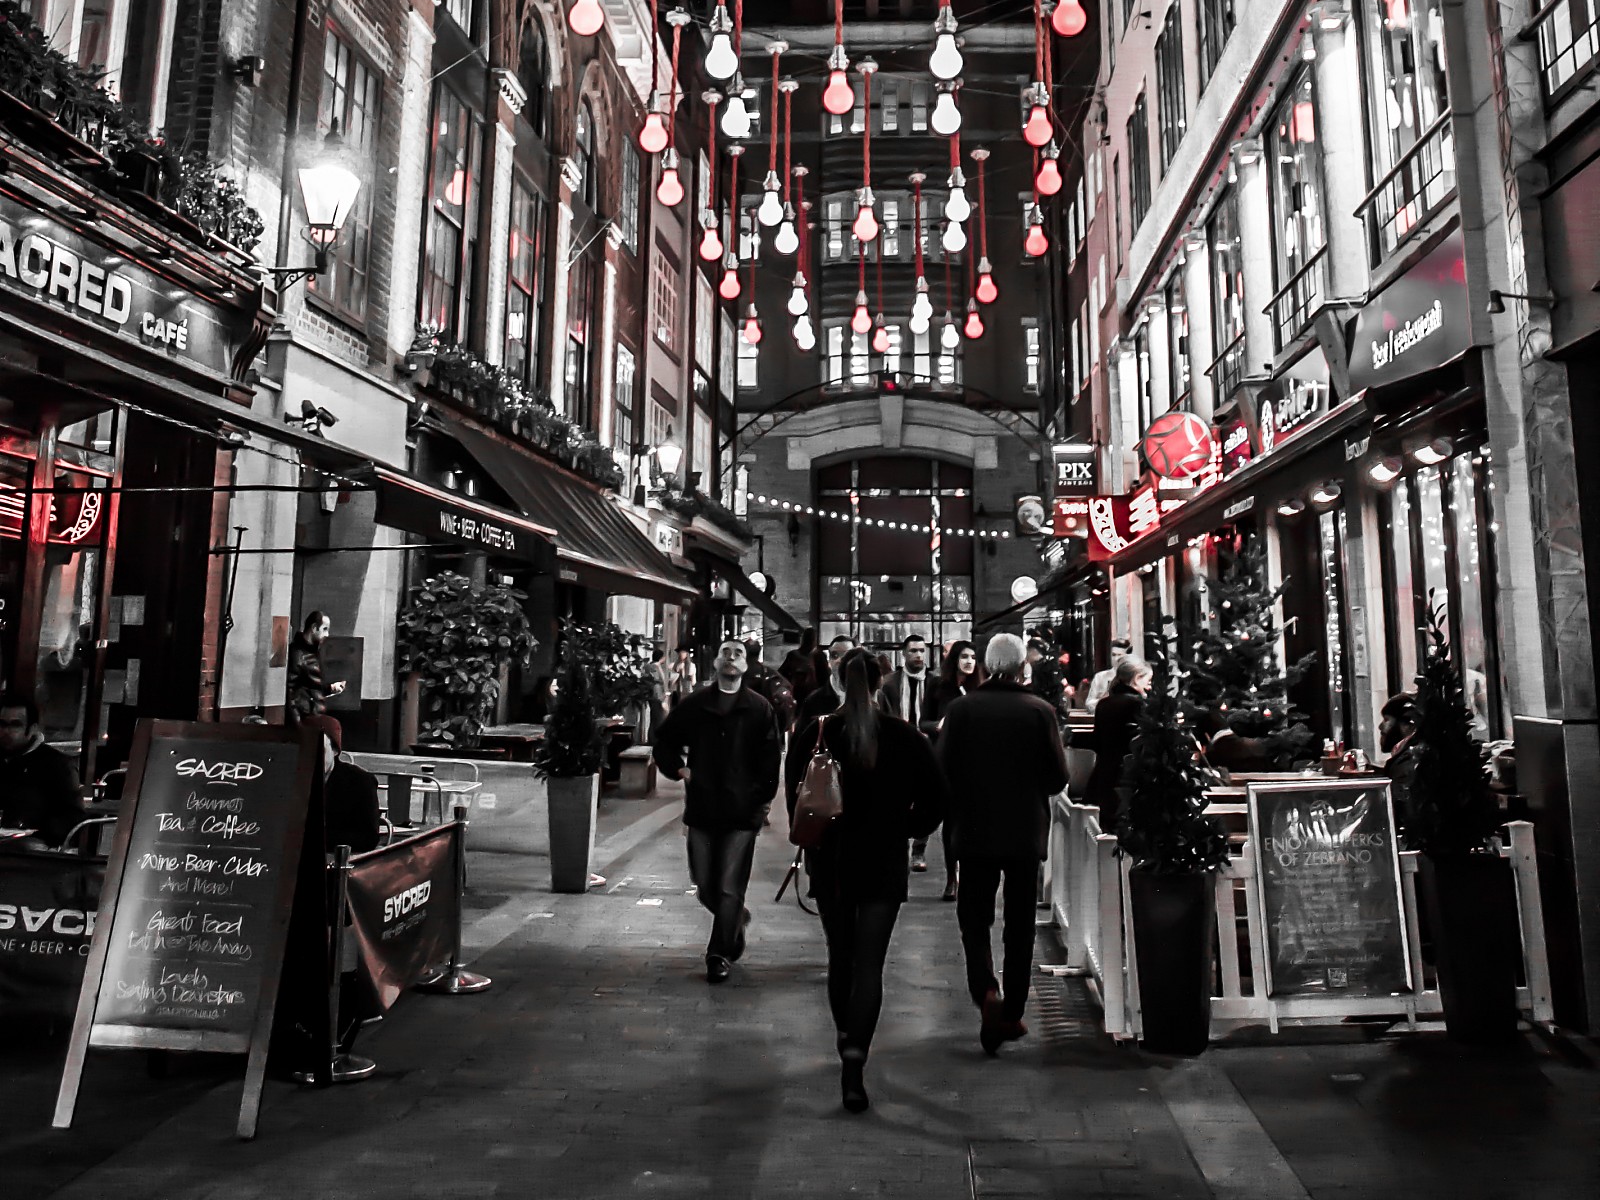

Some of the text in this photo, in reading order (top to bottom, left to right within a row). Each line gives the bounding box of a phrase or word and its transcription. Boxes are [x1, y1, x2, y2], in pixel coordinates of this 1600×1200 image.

[0, 218, 188, 350] ACRED CAFÉ
[1058, 462, 1092, 479] PIX
[440, 510, 516, 550] WINE BEER COFFEE TEA
[175, 758, 264, 780] SACRED
[155, 813, 185, 832] Tea
[201, 814, 261, 839] Coffee
[1264, 837, 1308, 852] ENJOY
[140, 853, 267, 877] Wine Beer Cider
[1279, 849, 1372, 867] OF ZEBRANO
[160, 877, 234, 896] And More!
[384, 880, 431, 923] SACRED
[147, 910, 242, 937] Great Food
[30, 940, 64, 955] BEER
[160, 966, 208, 991] Lovely
